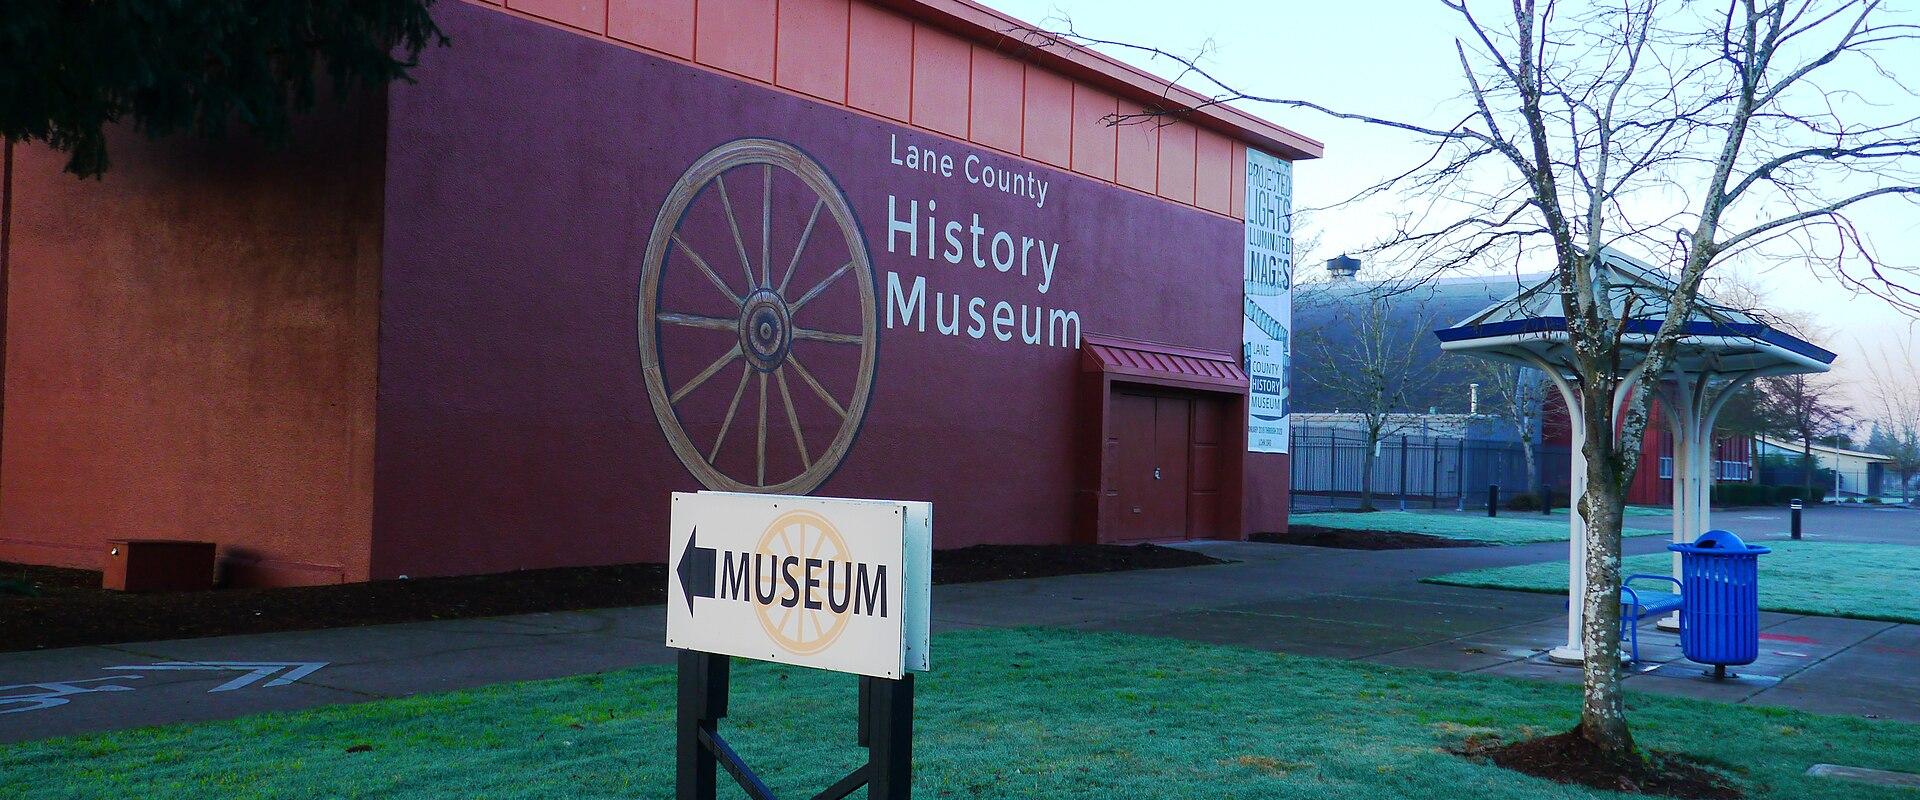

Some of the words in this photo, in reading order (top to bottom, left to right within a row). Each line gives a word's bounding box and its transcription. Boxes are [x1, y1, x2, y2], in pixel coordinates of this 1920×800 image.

[890, 133, 954, 178] Lane
[964, 154, 1049, 208] County
[1248, 162, 1291, 197] PROJECTED
[1248, 186, 1291, 234] LIGHTS
[888, 195, 1060, 294] History
[1247, 250, 1291, 290] IMAGES
[886, 271, 1081, 350] Museum
[1252, 361, 1280, 376] COUNTY
[1253, 344, 1269, 357] LANE
[1251, 396, 1281, 410] MUSEUM
[1252, 378, 1280, 394] HISTORY
[720, 550, 888, 618] MUSEUM
